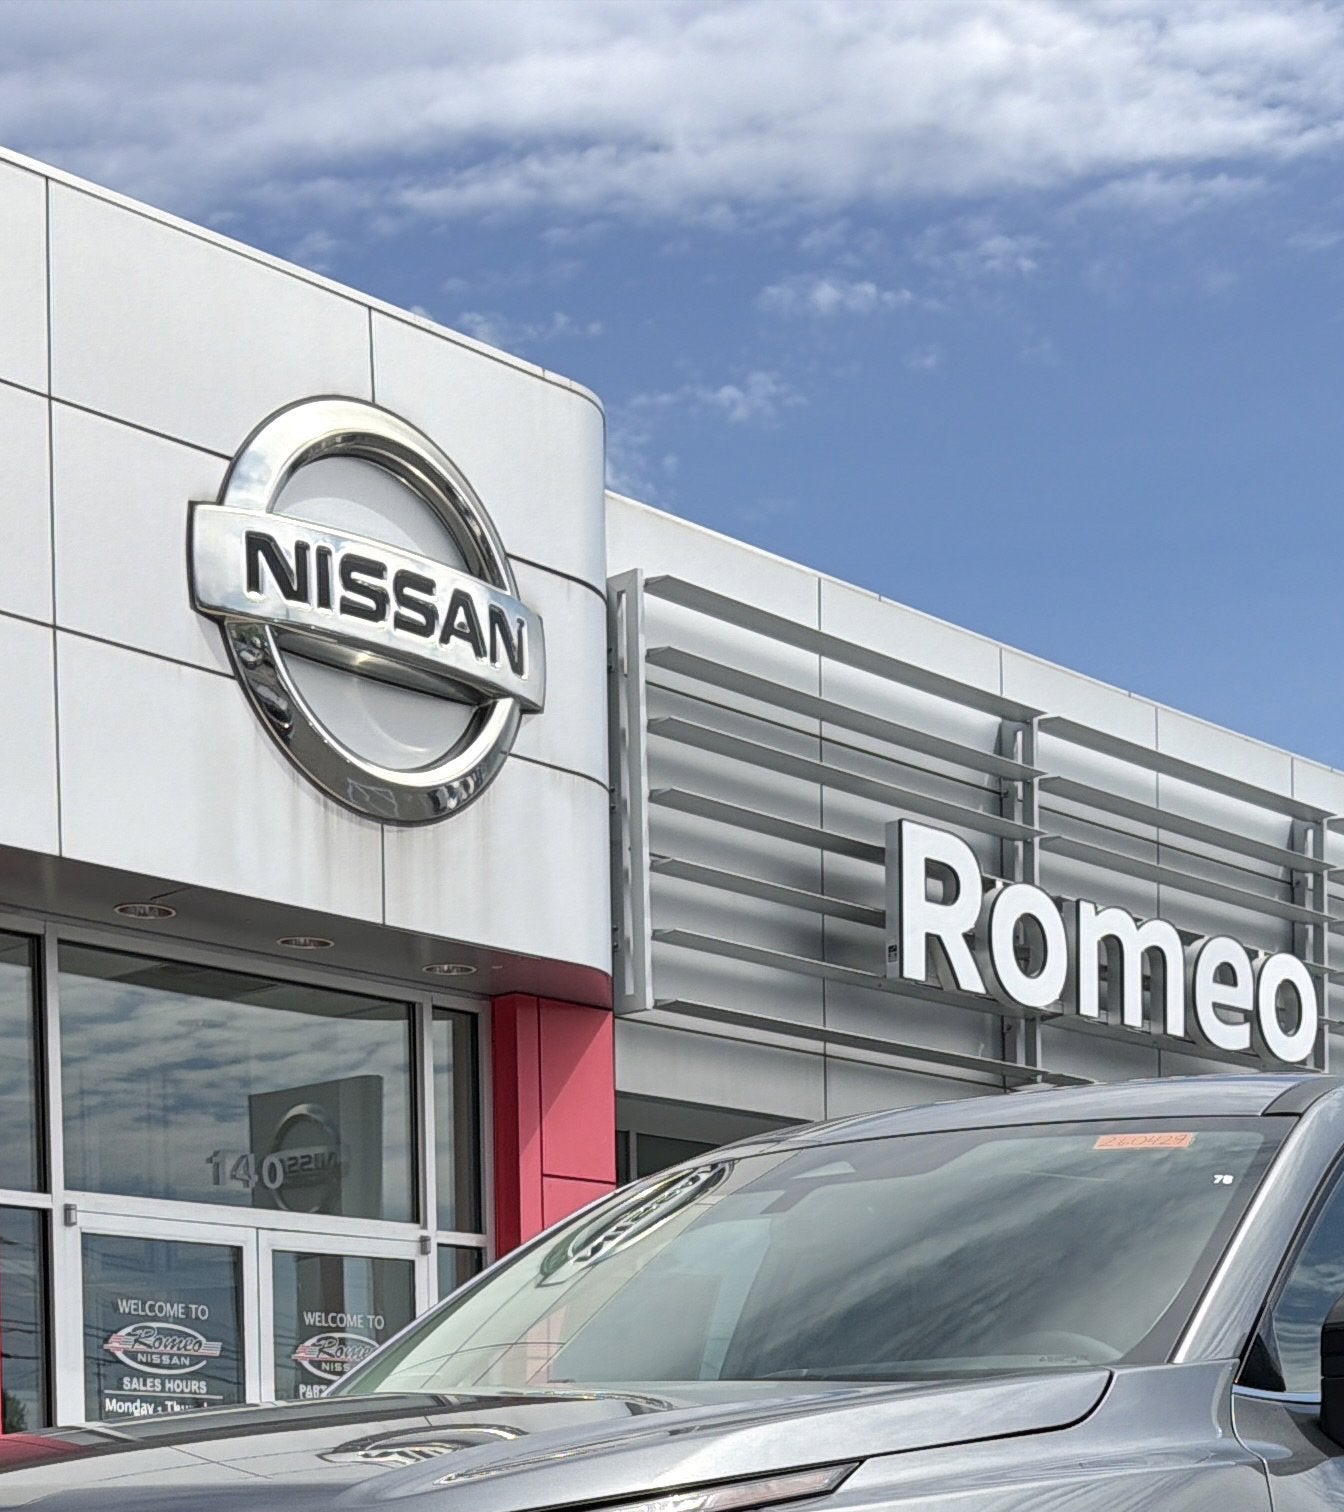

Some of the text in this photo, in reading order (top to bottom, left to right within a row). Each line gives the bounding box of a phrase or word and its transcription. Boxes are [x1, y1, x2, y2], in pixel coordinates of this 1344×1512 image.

[244, 529, 528, 680] NISSAN
[899, 818, 1319, 1064] Romeo
[207, 1150, 284, 1190] 140
[117, 1298, 209, 1321] WELCOME TO
[303, 1311, 385, 1330] WELCOME TO
[127, 1325, 205, 1353] Romeo
[137, 1352, 190, 1366] NISSAN
[321, 1362, 351, 1372] NISS
[122, 1376, 207, 1394] SALES HOURS
[105, 1397, 155, 1417] Monday
